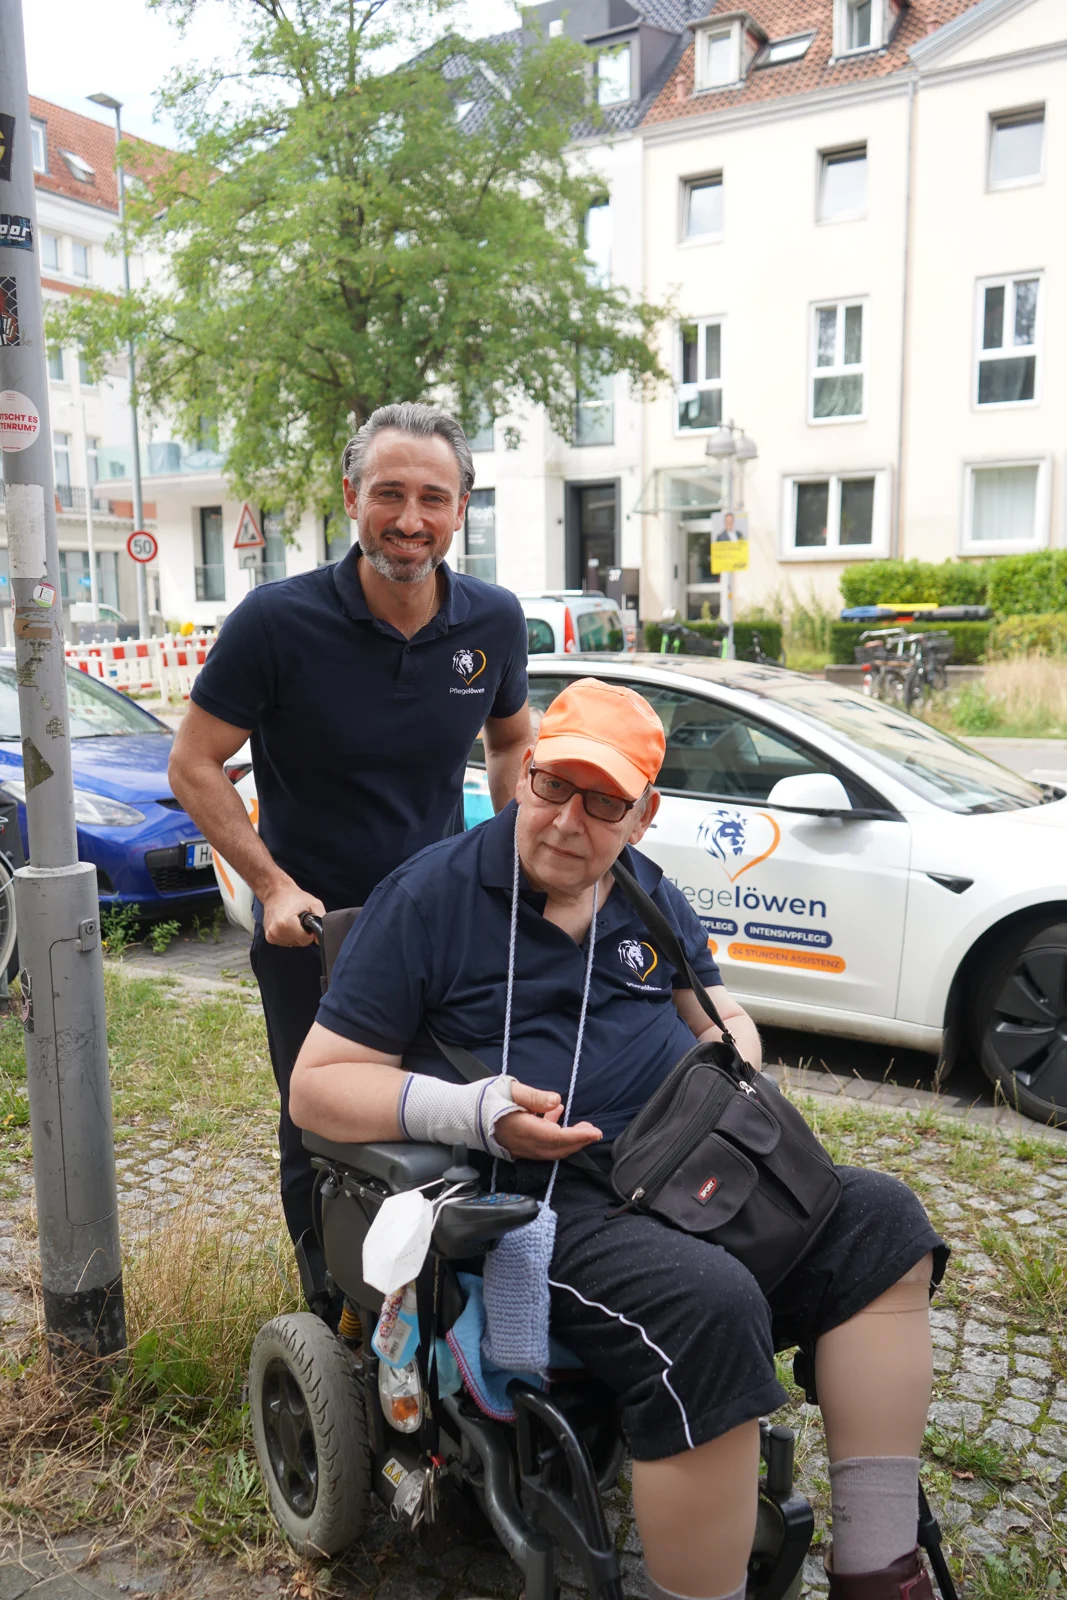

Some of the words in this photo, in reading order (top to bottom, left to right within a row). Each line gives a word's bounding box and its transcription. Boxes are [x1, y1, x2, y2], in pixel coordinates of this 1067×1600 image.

[0, 413, 26, 421] TSCHT
[28, 415, 38, 423] ES
[133, 540, 151, 554] 50
[201, 846, 209, 861] H
[667, 878, 827, 918] egelöwen
[749, 926, 827, 944] INTENSIVPFLEGE
[732, 947, 743, 955] 24
[745, 949, 788, 961] STUNDEN
[790, 954, 841, 968] ASSISTENZ
[700, 1179, 715, 1198] SPORT
